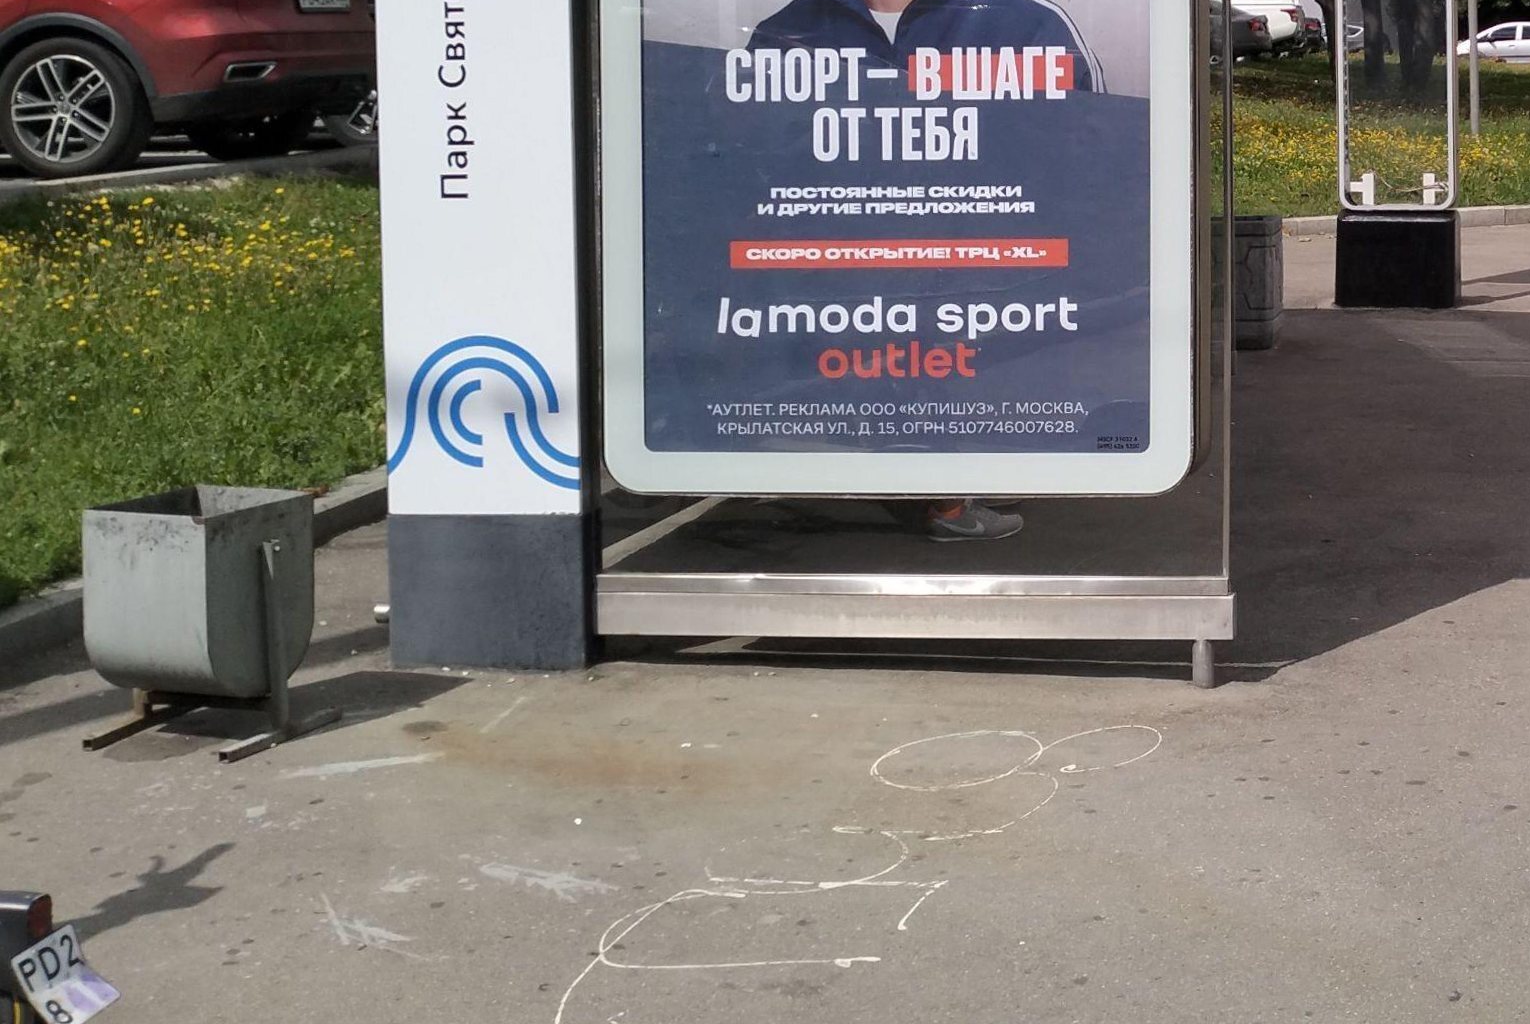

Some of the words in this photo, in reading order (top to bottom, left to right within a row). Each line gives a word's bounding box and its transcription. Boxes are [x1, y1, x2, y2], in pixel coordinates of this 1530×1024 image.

[915, 47, 941, 100] В
[952, 46, 1067, 100] ШАГЕ
[813, 107, 866, 162] ОТ
[874, 107, 978, 161] ТЕБЯ
[440, 101, 475, 200] Парк
[770, 187, 925, 199] ПОСТОЯННЫЕ
[928, 186, 1022, 199] СКИДКИ
[757, 204, 774, 215] И
[777, 203, 862, 216] ДРУГИЕ
[865, 202, 1035, 216] ПРЕДЛОЖЕНИЯ
[746, 248, 821, 261] СКОРО
[825, 247, 951, 260] ОТКРЫТИЕ!
[955, 247, 1000, 260] ТРЦ
[717, 296, 917, 338] lamoda
[936, 297, 1078, 340] sport
[779, 403, 857, 416] РЕКЛАМА
[859, 403, 896, 416] ООО
[1001, 402, 1012, 415] Г.
[1015, 402, 1089, 416] МОСКВА,
[717, 422, 824, 435] КРЫЛАТСКАЯ
[858, 422, 874, 436] Д.
[878, 422, 899, 437] 15,
[902, 421, 945, 435] ОГРН
